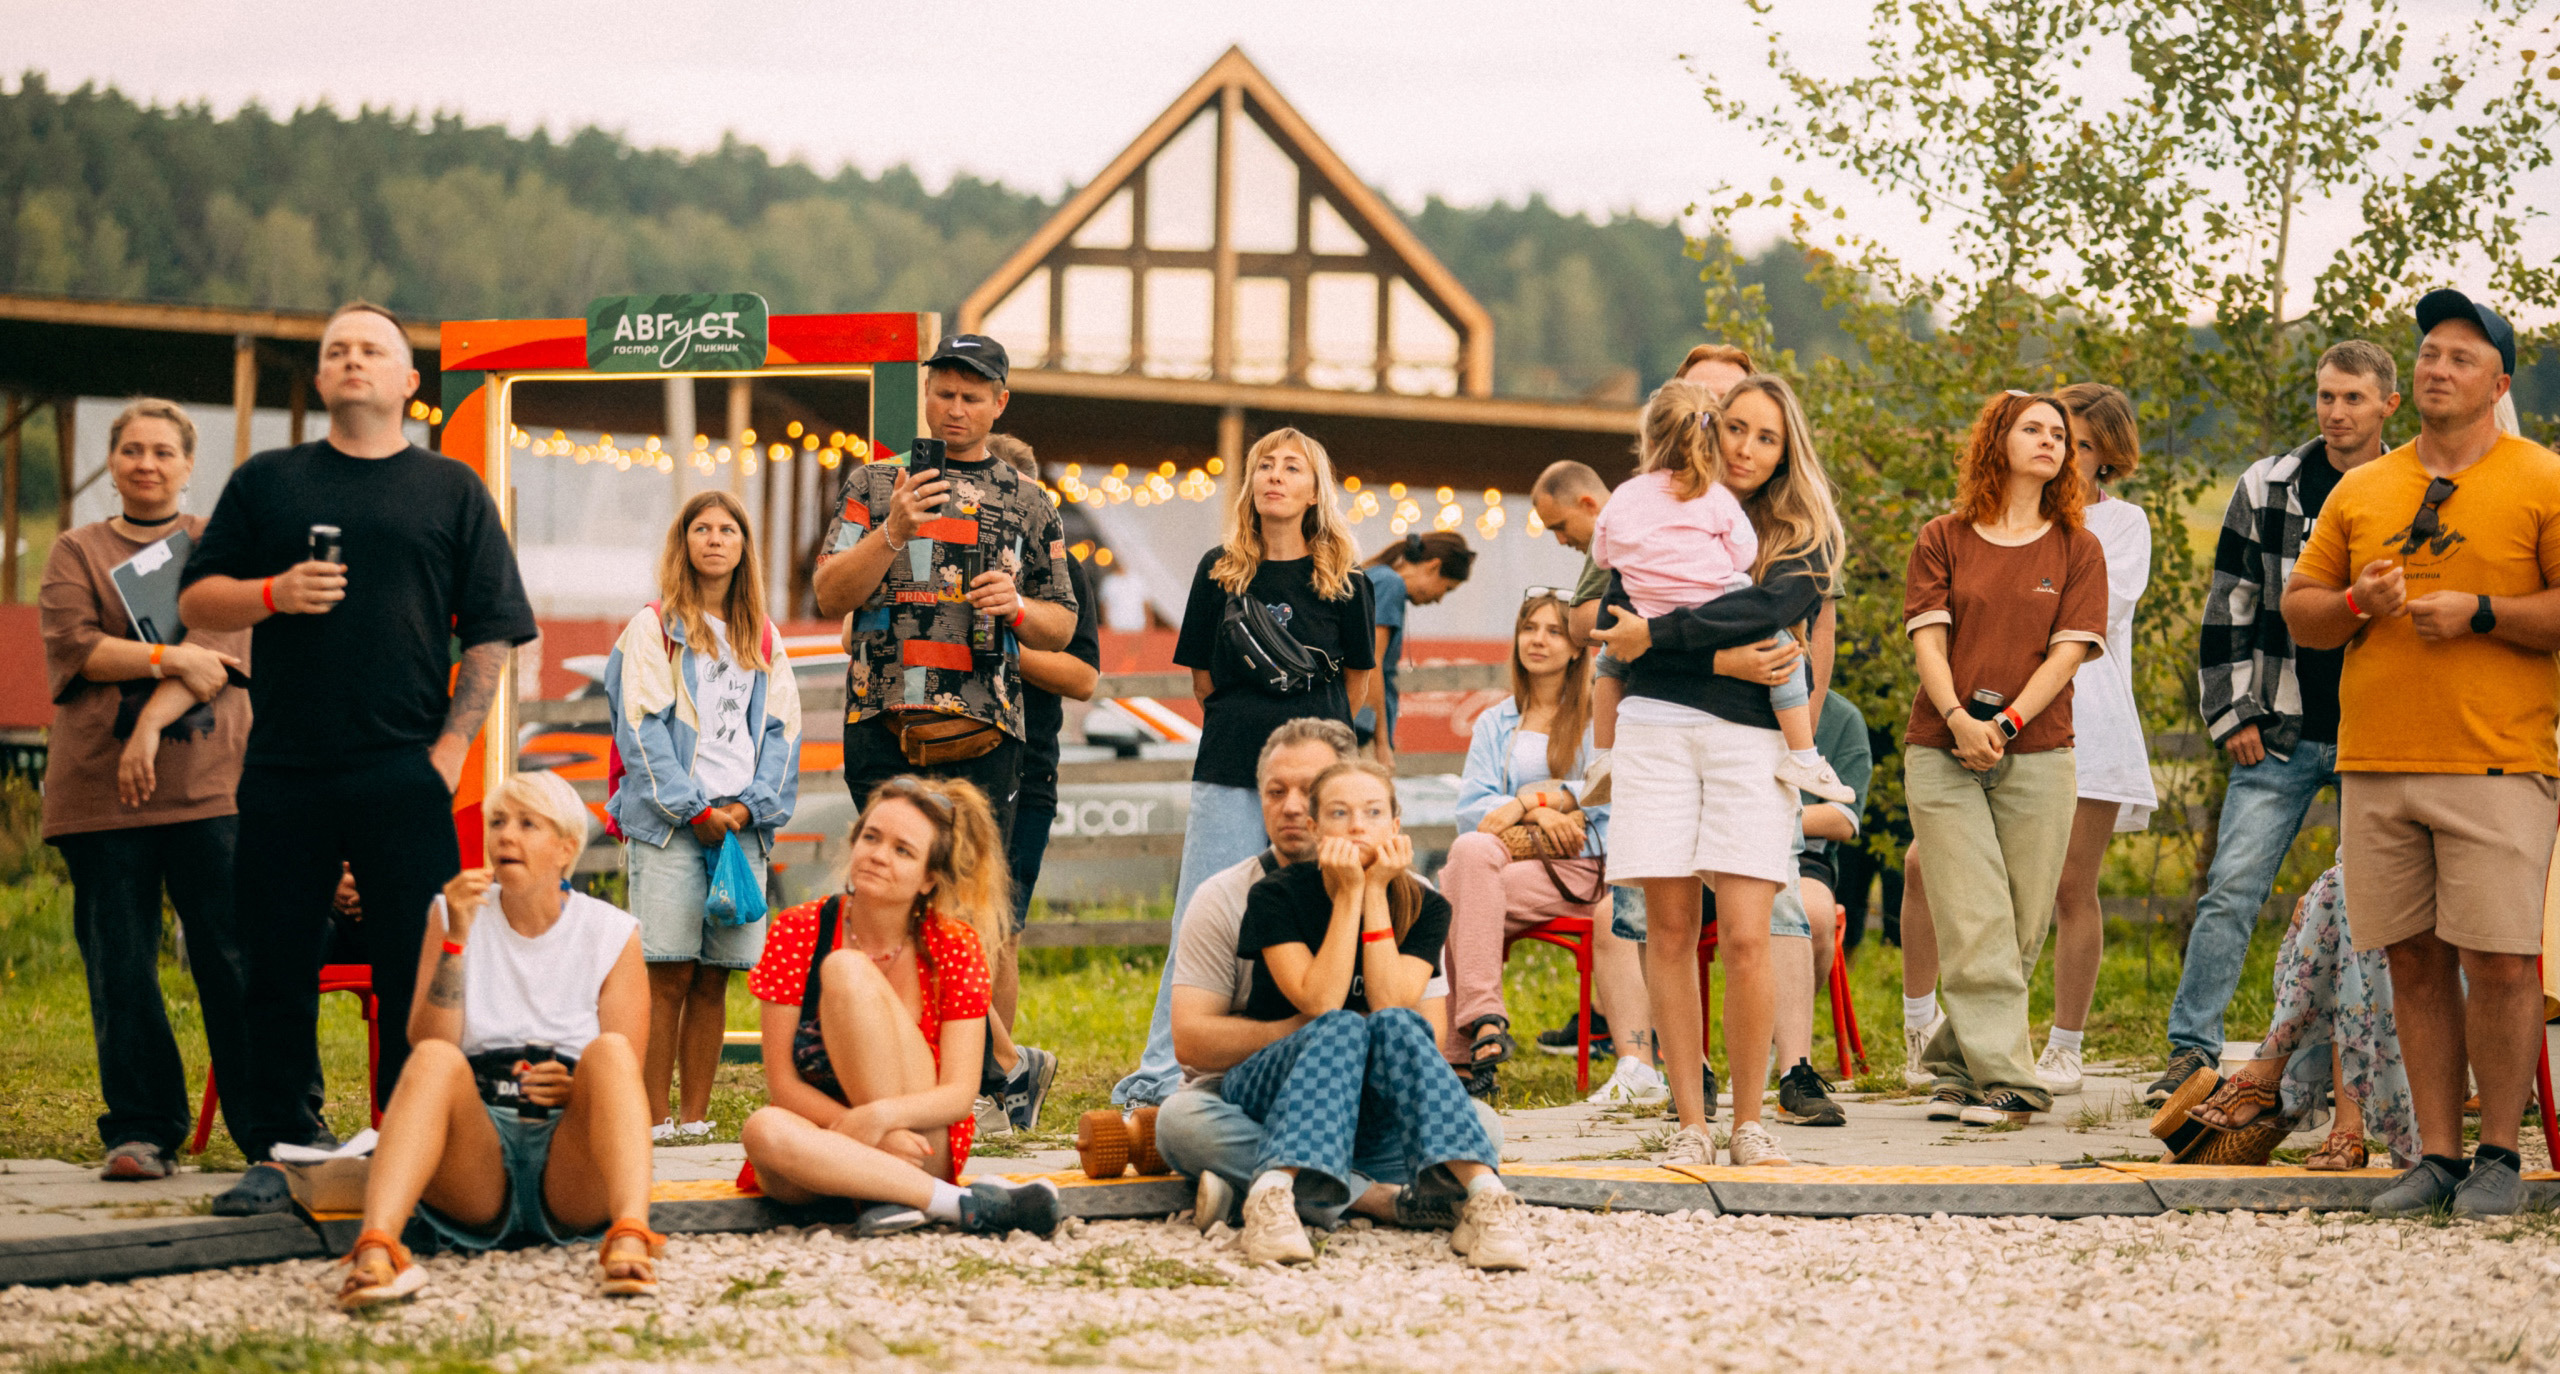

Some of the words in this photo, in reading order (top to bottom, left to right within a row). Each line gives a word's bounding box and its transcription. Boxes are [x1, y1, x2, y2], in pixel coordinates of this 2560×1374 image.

[613, 345, 659, 355] гастро
[695, 343, 739, 353] пикник
[897, 592, 938, 604] PRINT
